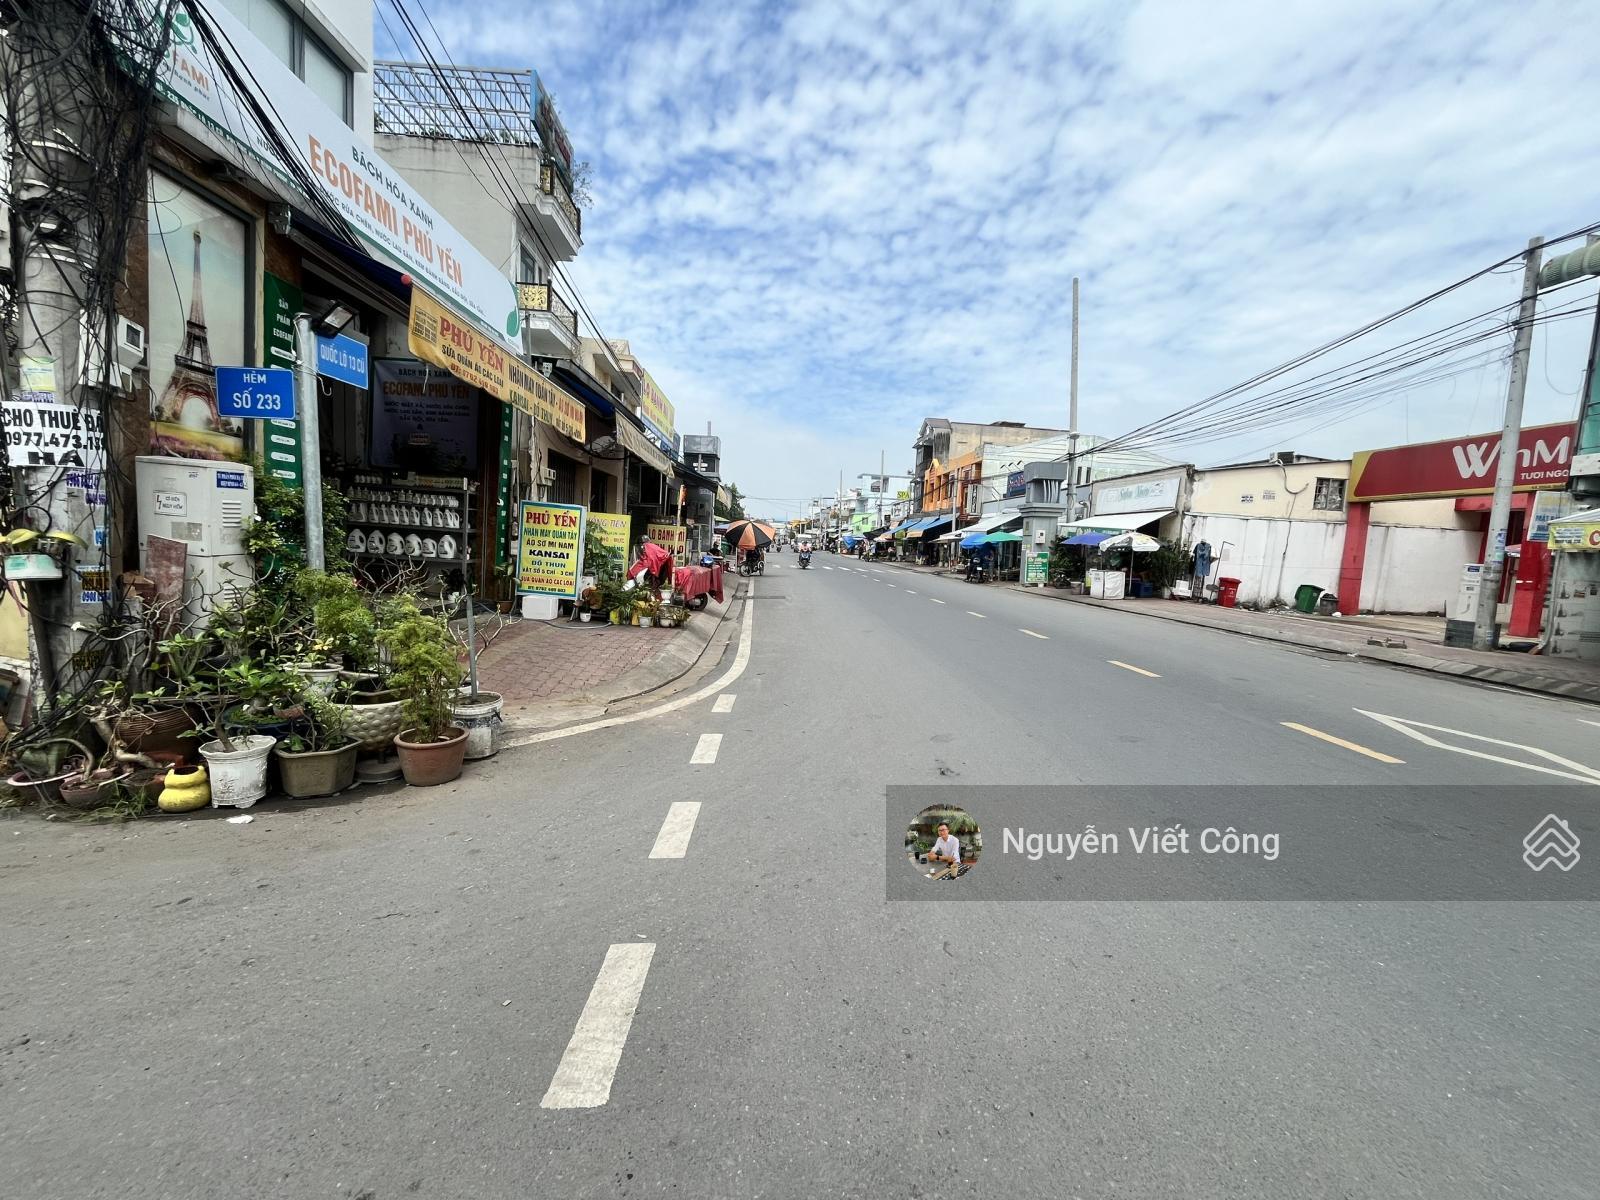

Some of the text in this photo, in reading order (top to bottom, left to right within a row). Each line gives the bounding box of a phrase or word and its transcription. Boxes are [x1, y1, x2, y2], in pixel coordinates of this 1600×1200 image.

[309, 134, 398, 236] ECOFAMI
[352, 145, 434, 231] BÁCH HÓA XANH
[320, 342, 338, 364] QUỐC
[349, 355, 356, 370] 13
[243, 370, 267, 384] HẺM
[233, 387, 281, 410] SỐ 233
[3, 408, 33, 428] CHO
[657, 527, 675, 541] BÁNH
[529, 549, 570, 560] KANSAI
[558, 541, 574, 550] NAM
